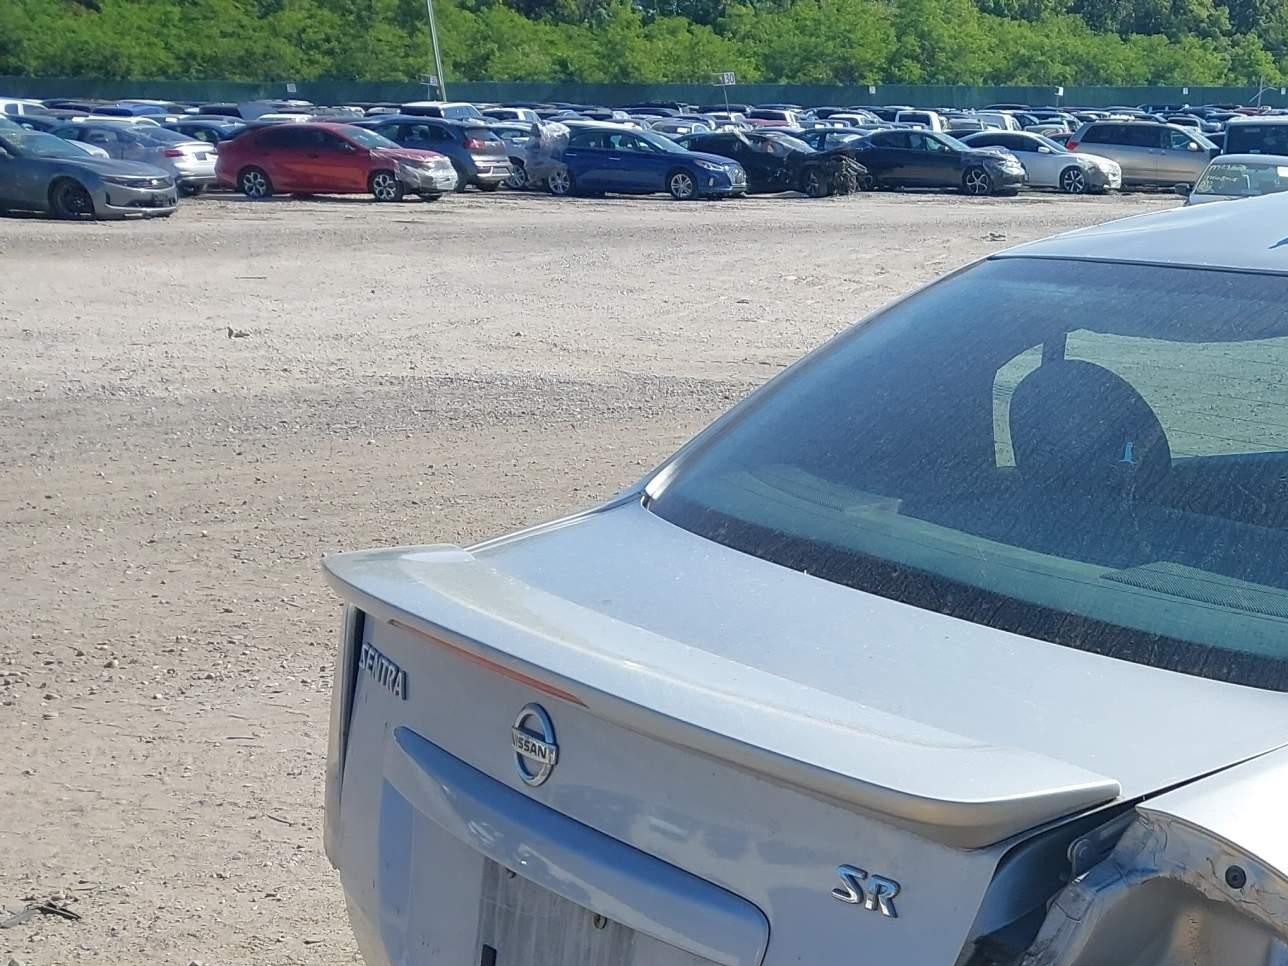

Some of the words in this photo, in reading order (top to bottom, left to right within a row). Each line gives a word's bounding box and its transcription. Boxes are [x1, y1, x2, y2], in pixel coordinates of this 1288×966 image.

[359, 643, 407, 701] SENTRA
[512, 729, 549, 761] NISSAN
[832, 863, 902, 919] SR
